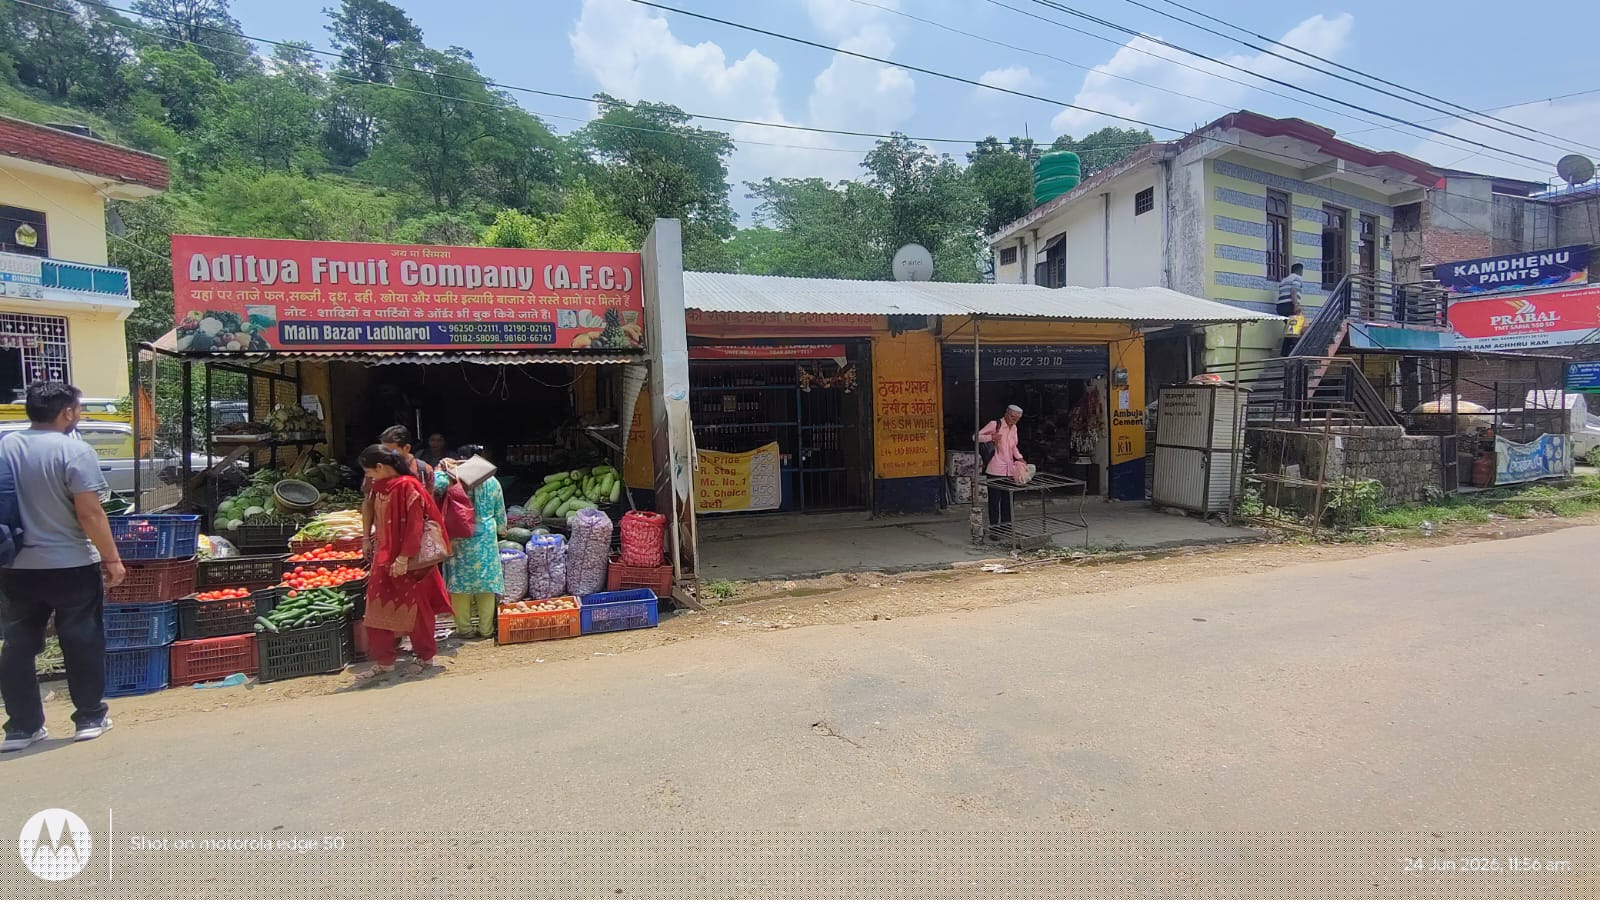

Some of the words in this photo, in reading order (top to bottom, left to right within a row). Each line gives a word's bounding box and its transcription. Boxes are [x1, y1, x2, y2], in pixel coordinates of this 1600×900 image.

[1454, 251, 1570, 277] KAMDHENU
[189, 253, 299, 286] Aditya
[311, 257, 389, 285] Fruit
[400, 259, 534, 291] Company
[544, 264, 633, 292] (A.F.C.)
[1479, 268, 1540, 284] PAINTS
[217, 290, 233, 301] पर
[236, 287, 260, 301] ताजे
[380, 289, 408, 304] खोया
[412, 290, 430, 304] और
[433, 290, 458, 304] पनीर
[461, 291, 493, 306] इत्यादि
[496, 295, 525, 305] बाजार
[527, 292, 536, 305] से
[538, 293, 560, 306] सस्ते
[584, 296, 596, 306] पर
[598, 293, 622, 307] मिलते
[363, 309, 371, 318] व
[414, 308, 424, 318] के
[457, 308, 469, 319] भी
[473, 310, 491, 321] बुक
[494, 308, 514, 319] किये
[518, 309, 538, 319] जाते
[1490, 310, 1561, 326] PRABAL
[284, 324, 319, 341] Main
[323, 325, 362, 341] Bazar
[366, 325, 430, 342] Ladbharol
[993, 356, 1016, 366] 1800
[1020, 356, 1032, 366] 22
[879, 376, 904, 397] ठेका
[1113, 409, 1143, 418] Ambuja
[1113, 418, 1143, 426] Cement
[891, 432, 927, 443] TRADER
[714, 456, 740, 464] Pride
[700, 467, 710, 475] R.
[714, 466, 737, 475] Stag
[722, 478, 739, 486] No.
[714, 489, 747, 497] Choice
